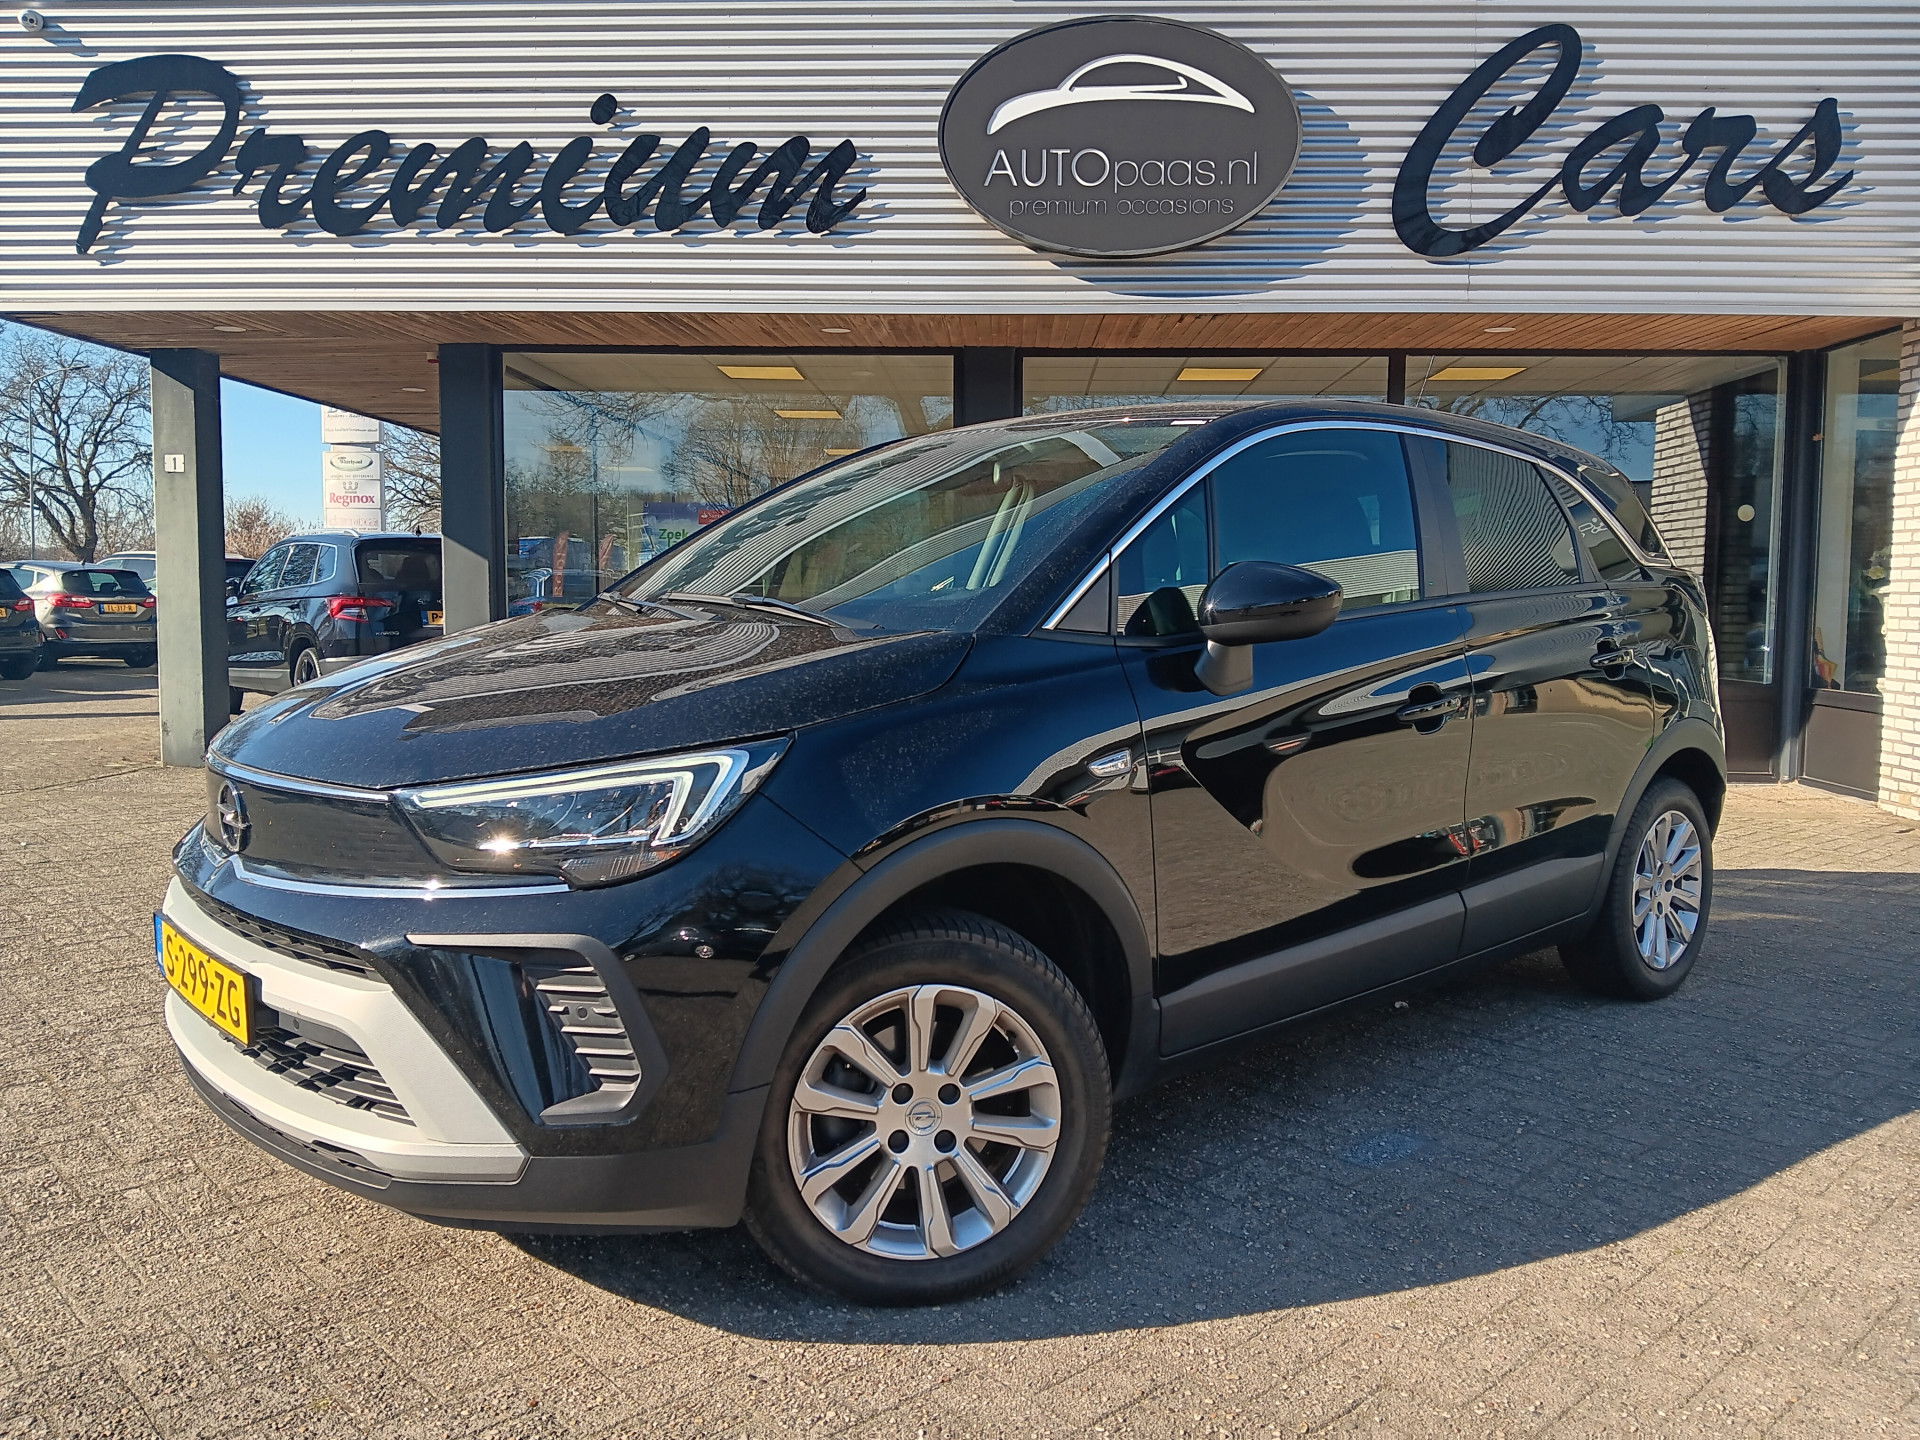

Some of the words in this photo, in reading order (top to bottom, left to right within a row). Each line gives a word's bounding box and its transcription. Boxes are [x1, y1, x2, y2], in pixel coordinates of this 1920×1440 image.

[71, 54, 867, 256] Premium
[984, 148, 1258, 193] AUTOpaas.nl
[1391, 23, 1855, 258] Cars
[1010, 196, 1107, 218] premium
[1116, 196, 1235, 214] occasions
[329, 492, 375, 507] Reginox
[166, 933, 241, 1029] S-299-ZG
